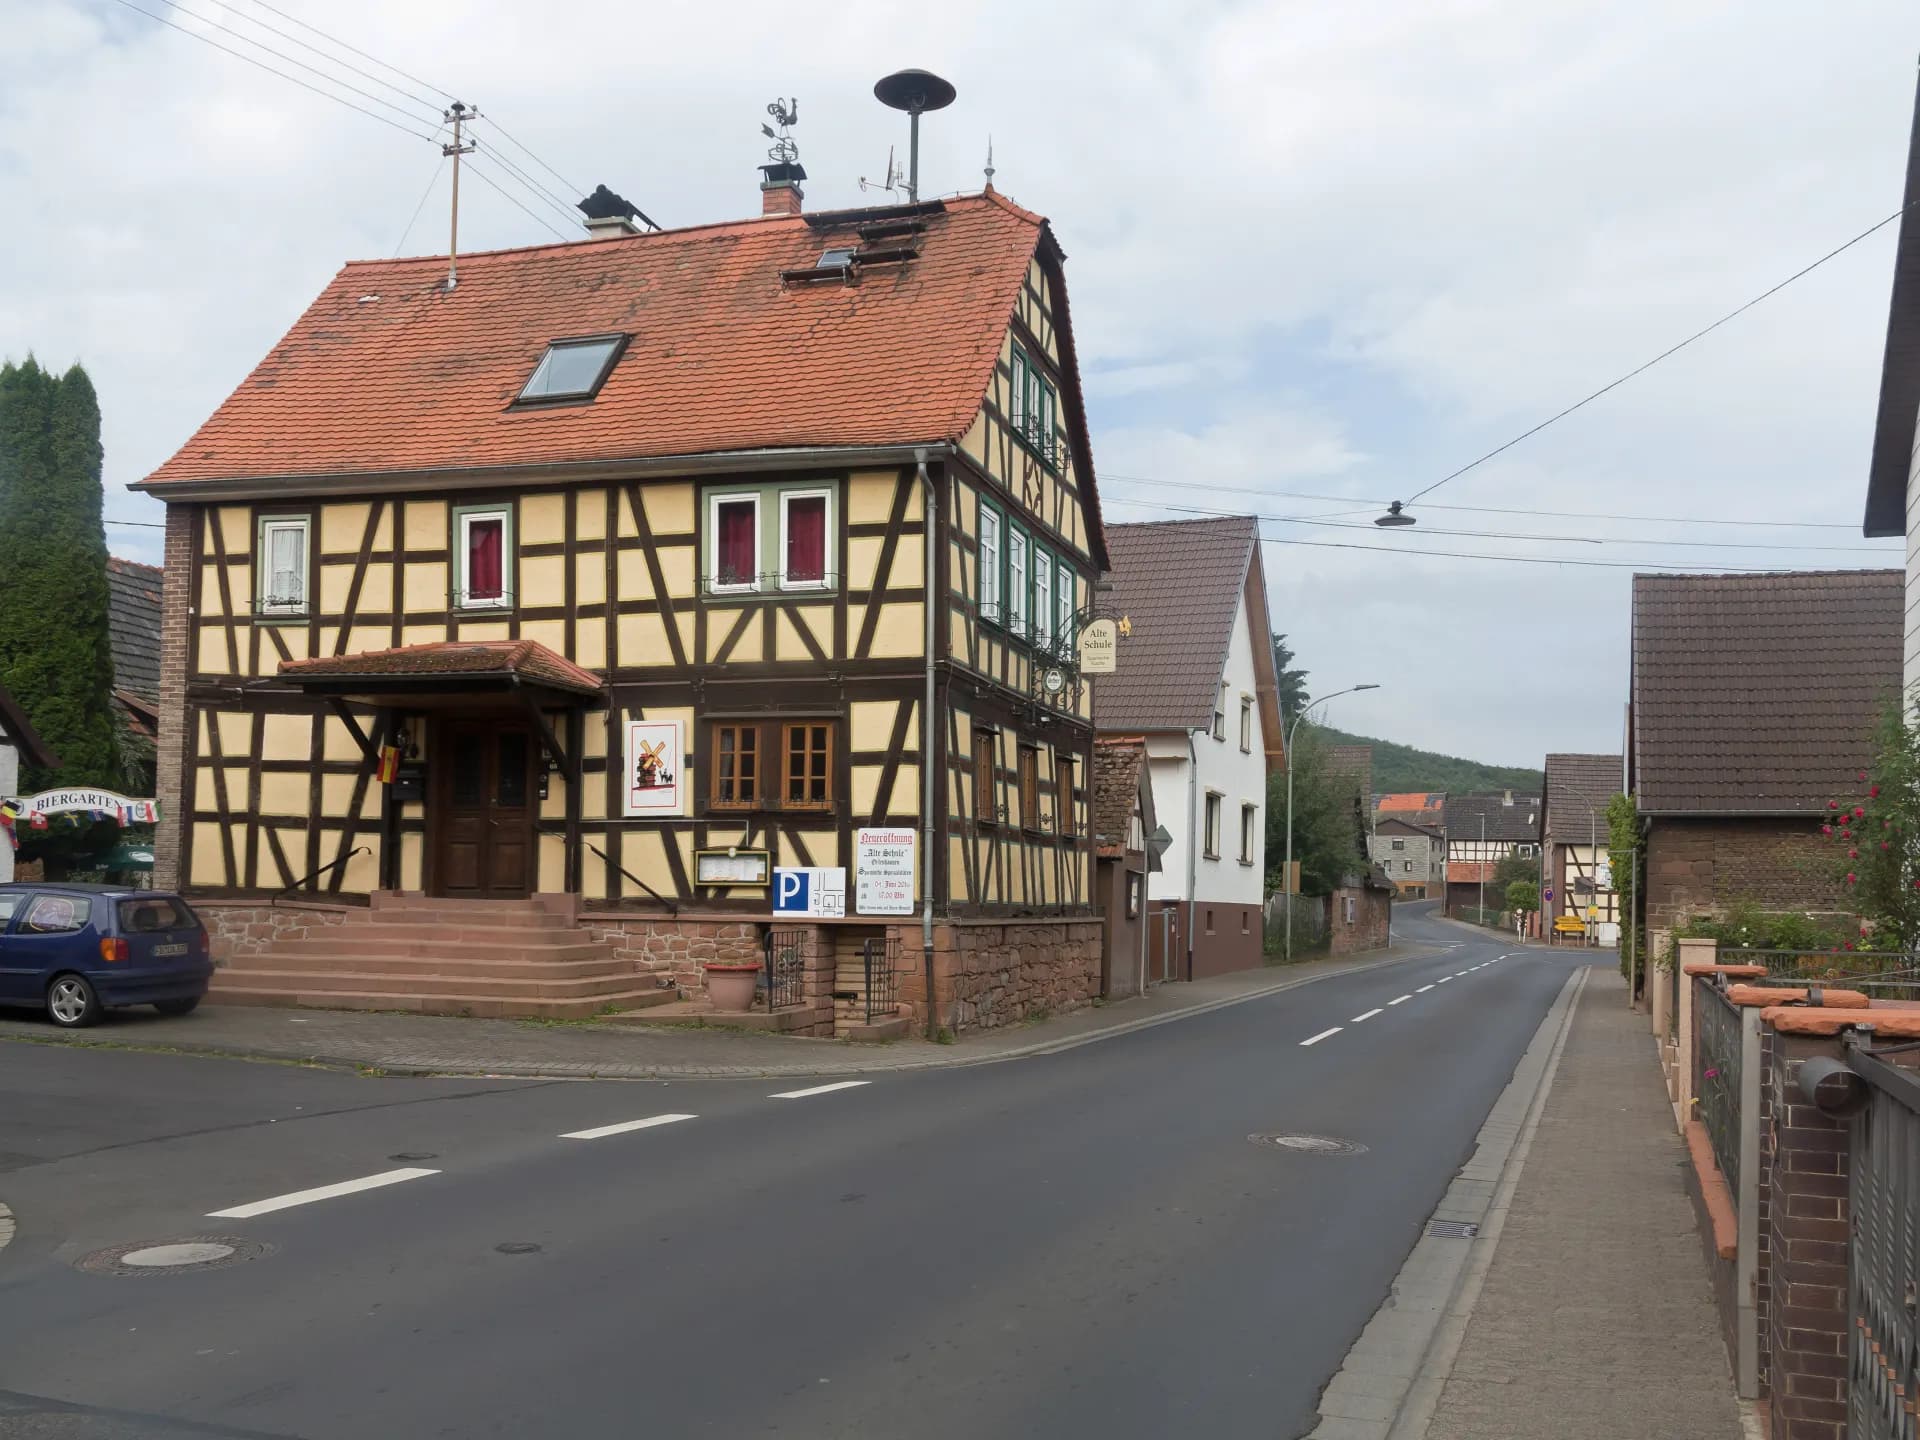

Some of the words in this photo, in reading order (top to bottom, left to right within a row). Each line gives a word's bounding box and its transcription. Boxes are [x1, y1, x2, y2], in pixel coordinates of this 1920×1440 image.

[1090, 628, 1108, 638] Alte
[1084, 640, 1113, 649] Schule
[37, 793, 123, 811] BIERGARTEN
[860, 833, 912, 845] Neueröffnung
[779, 872, 801, 908] P
